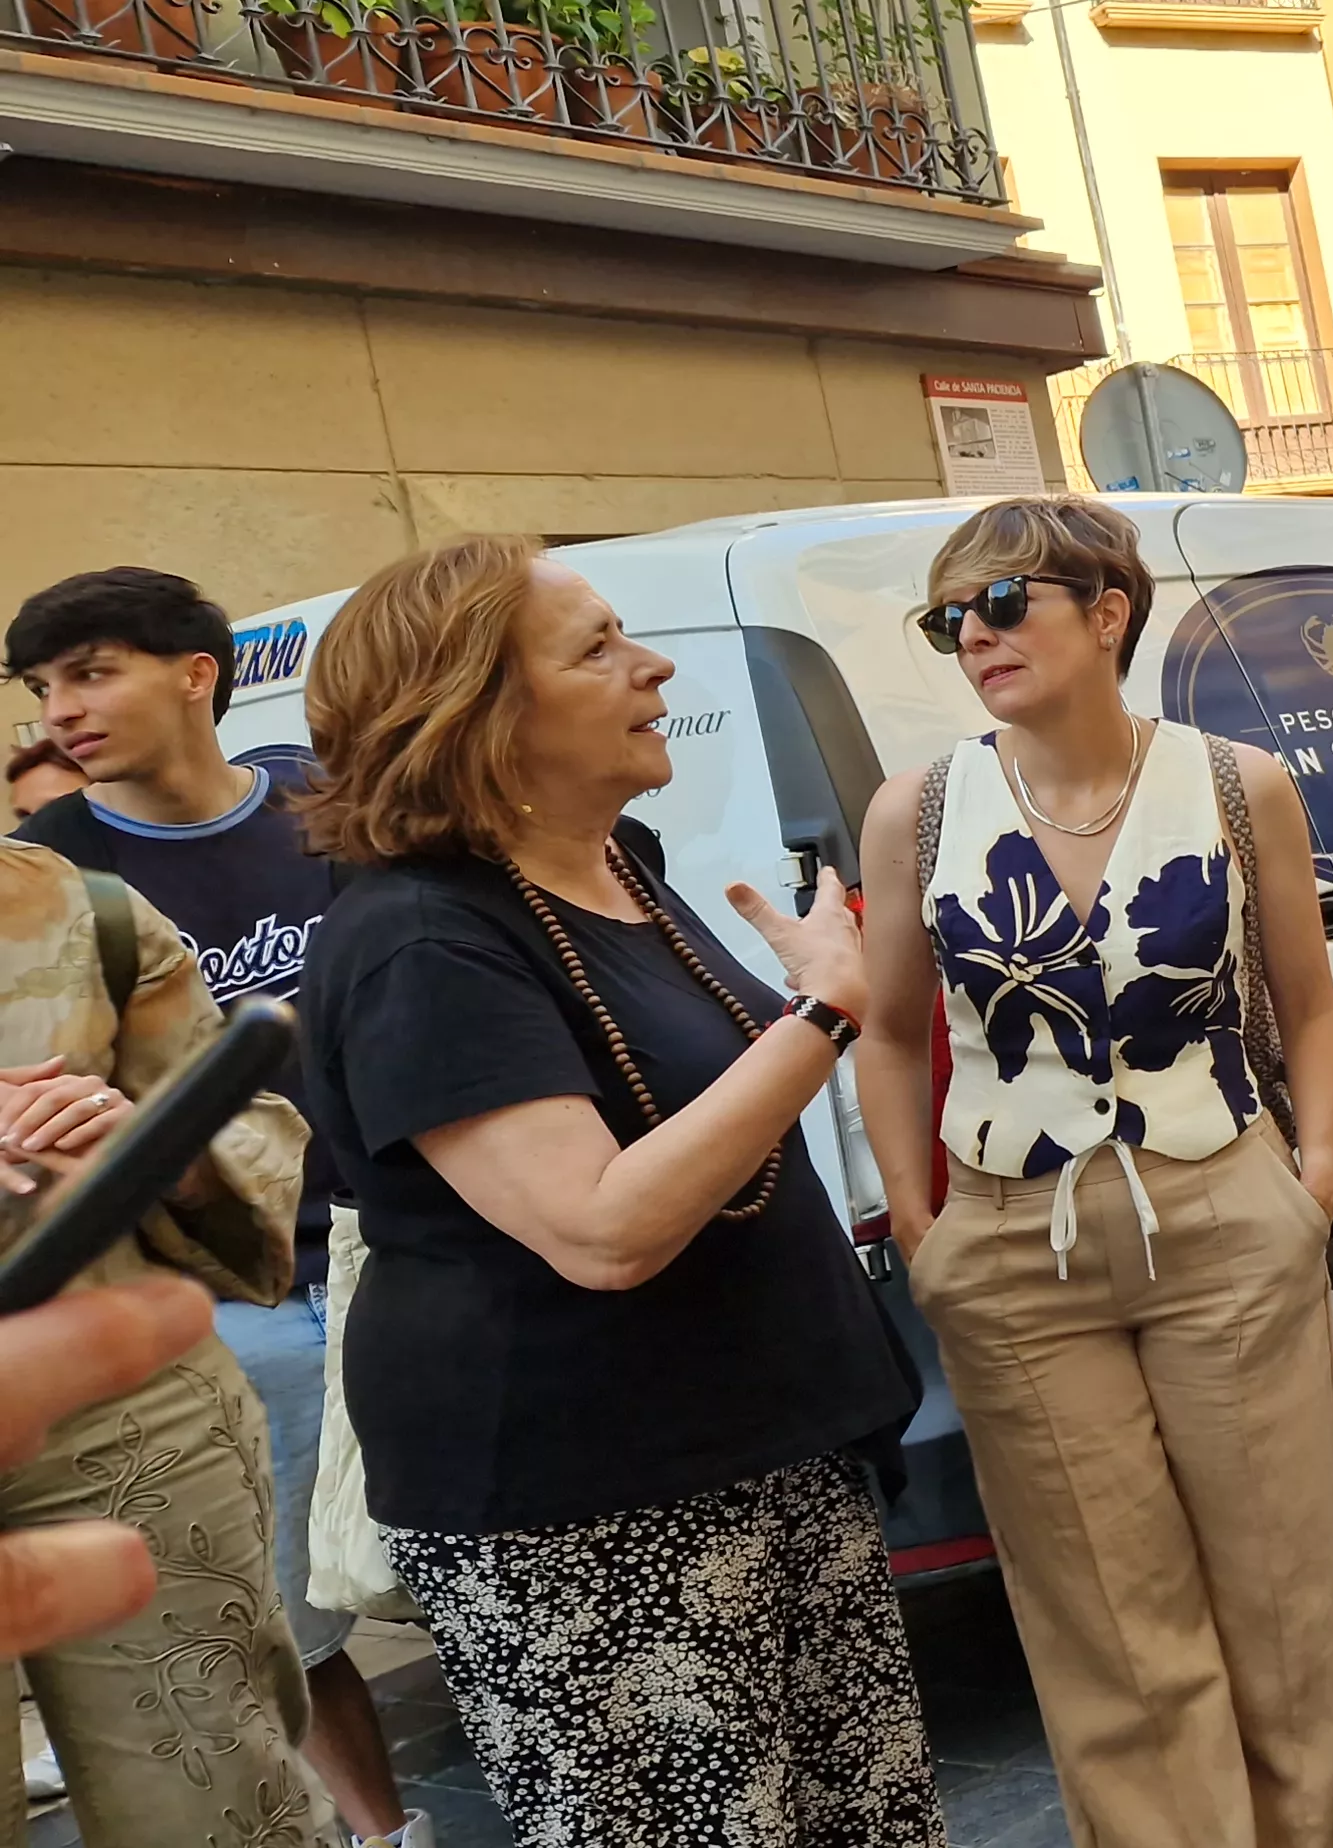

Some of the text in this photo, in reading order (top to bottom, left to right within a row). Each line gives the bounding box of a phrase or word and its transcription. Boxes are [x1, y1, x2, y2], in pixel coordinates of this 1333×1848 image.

[934, 380, 950, 392] Calle
[951, 382, 960, 393] de
[961, 381, 985, 394] SANTA
[667, 709, 732, 740] mar
